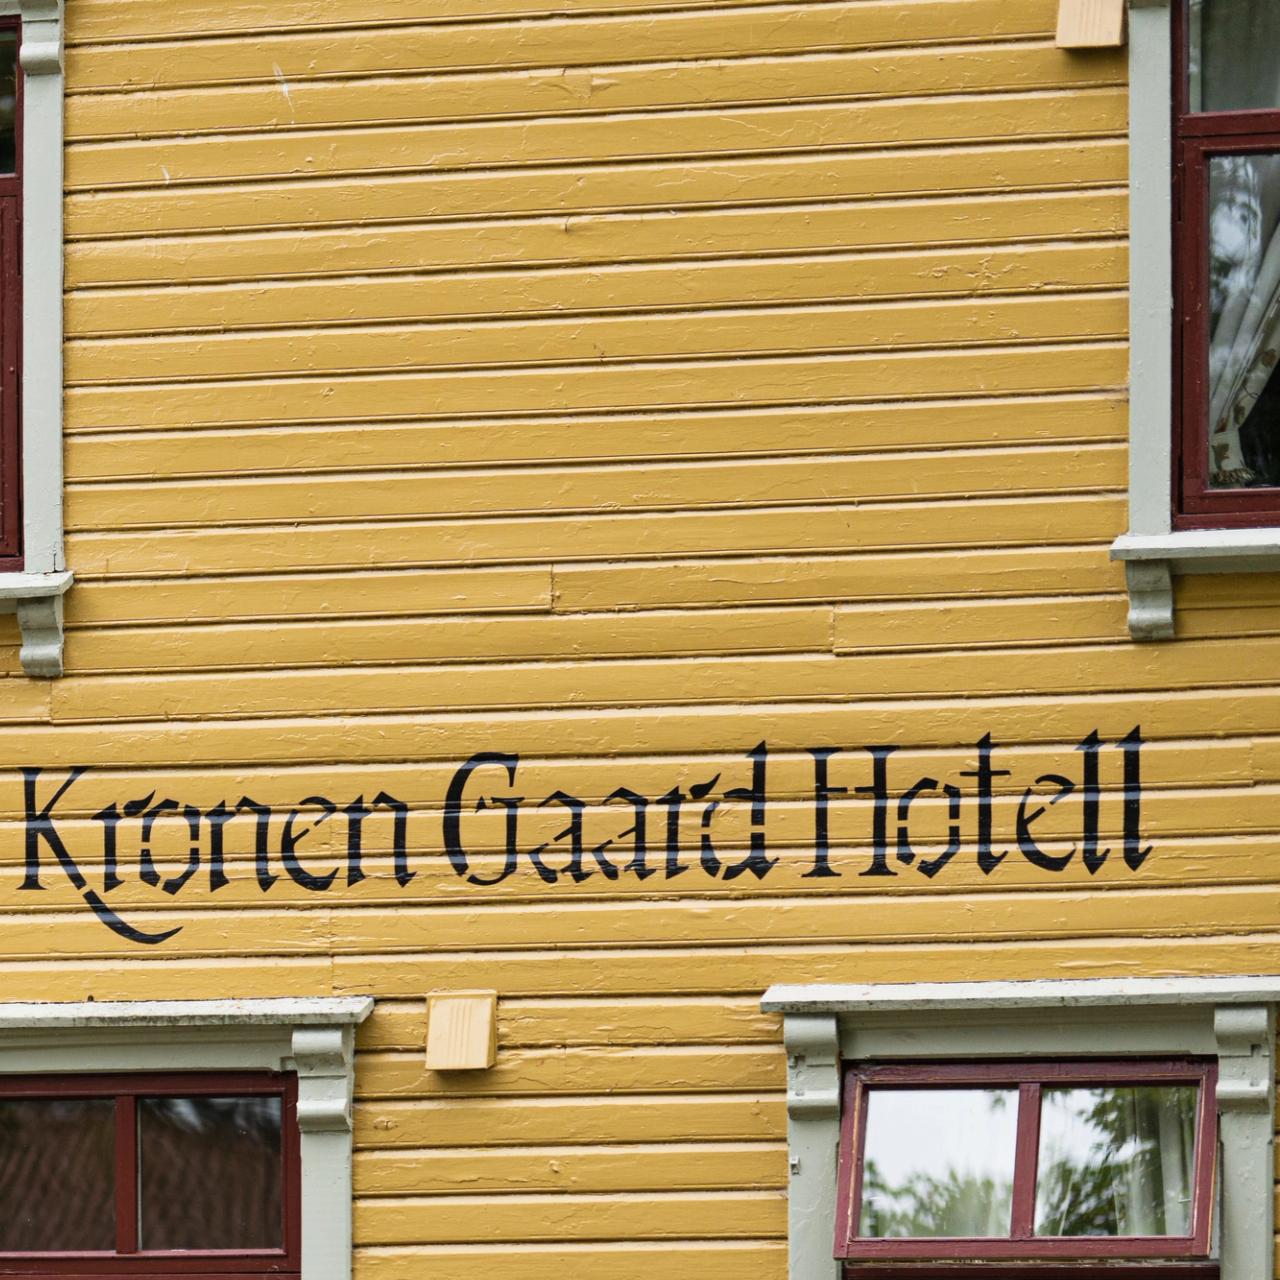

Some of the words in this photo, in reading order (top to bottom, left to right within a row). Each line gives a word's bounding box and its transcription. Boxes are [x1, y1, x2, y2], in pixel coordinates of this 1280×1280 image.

[17, 765, 418, 945] Kronen
[442, 740, 782, 887] Gaard
[802, 723, 1152, 880] Hotell
